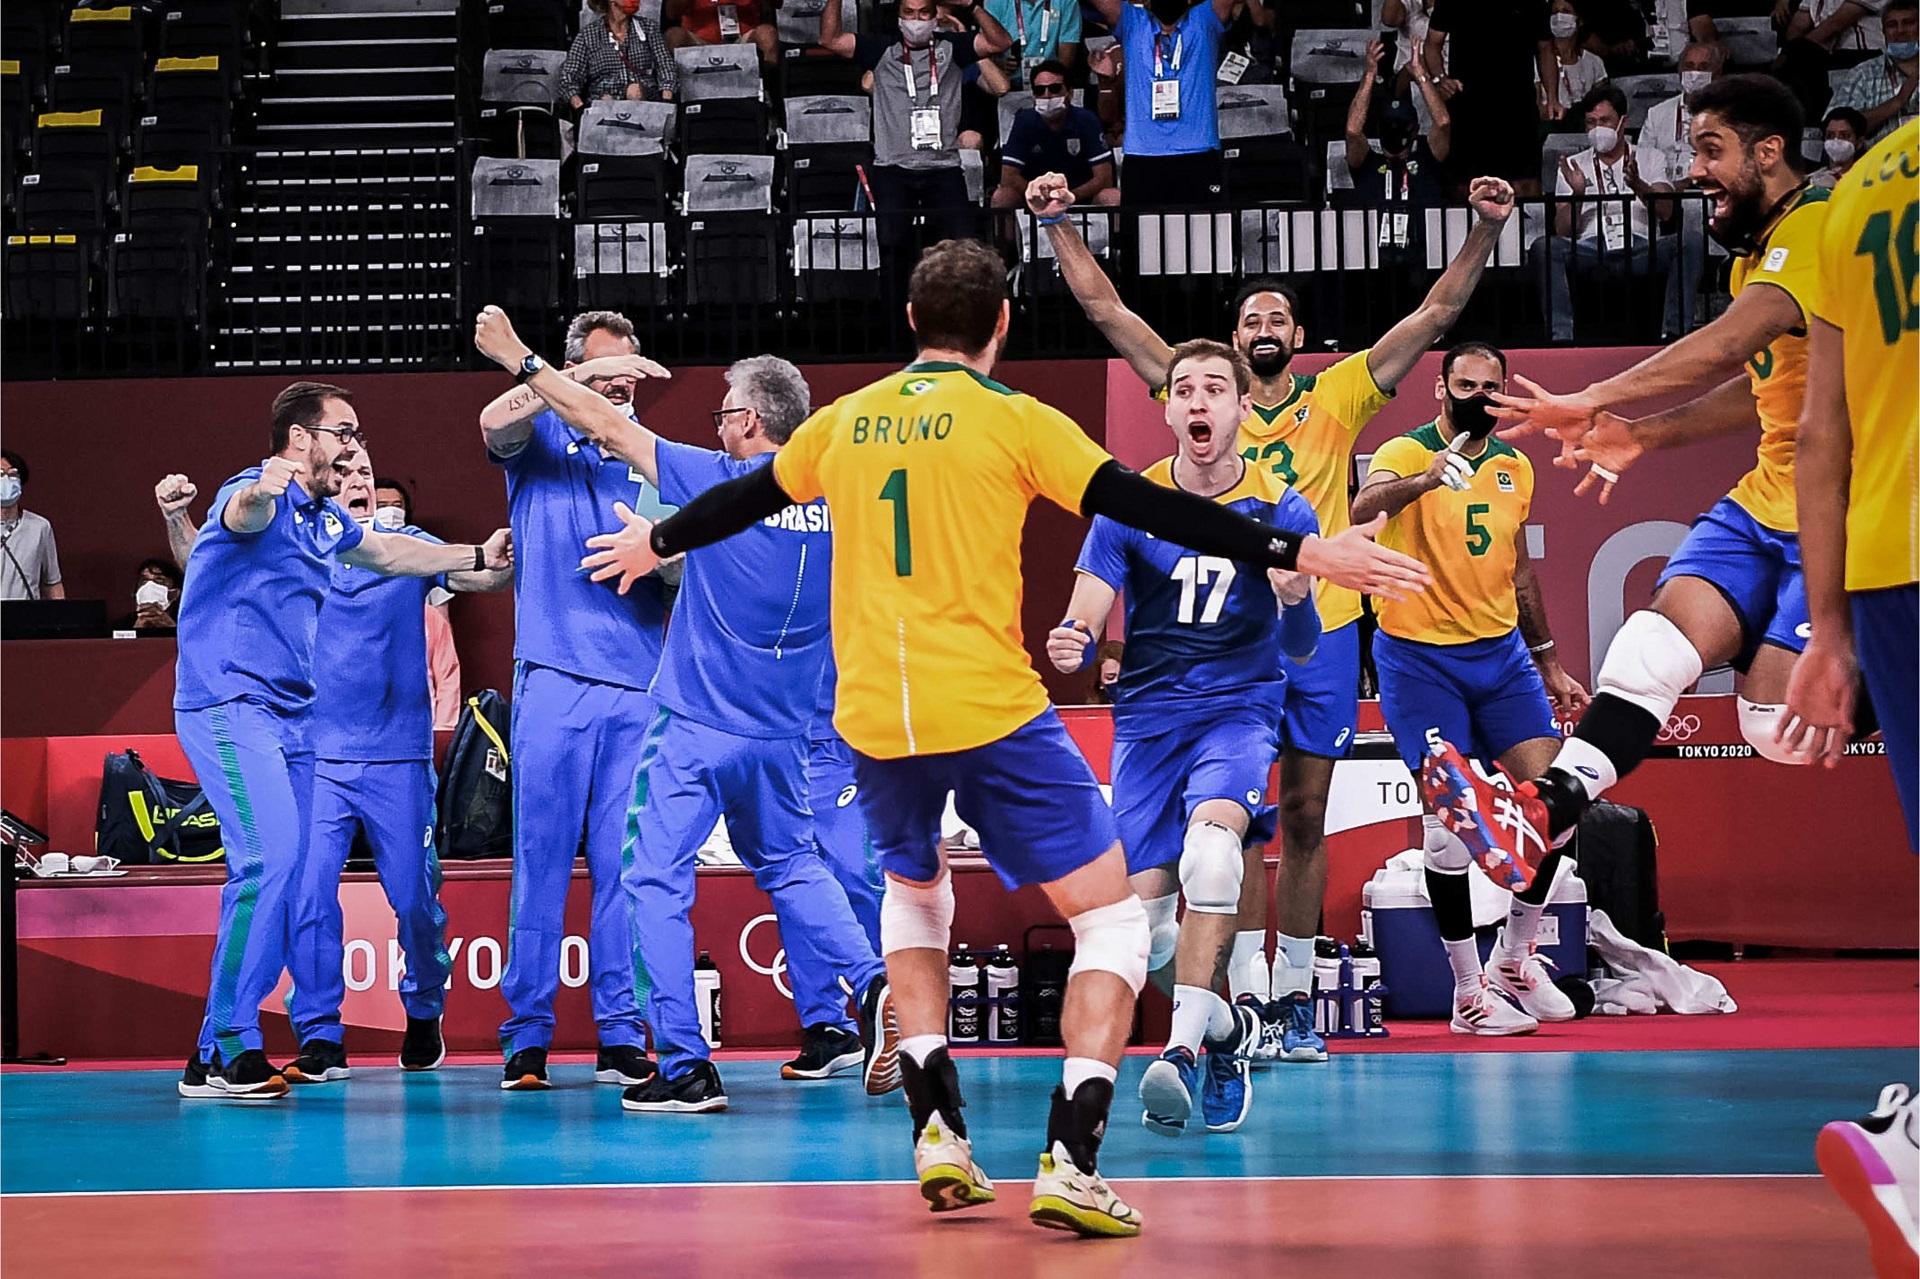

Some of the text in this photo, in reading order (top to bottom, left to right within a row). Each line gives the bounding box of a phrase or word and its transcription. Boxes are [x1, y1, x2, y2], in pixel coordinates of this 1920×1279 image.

[852, 413, 953, 444] BRUNO
[764, 504, 833, 532] RASI
[878, 468, 912, 577] 1
[1465, 503, 1492, 556] 5
[1170, 555, 1236, 624] 17
[1677, 745, 1752, 758] TOKYO 2020
[1843, 742, 1876, 755] KYO
[343, 936, 502, 991] OKYO
